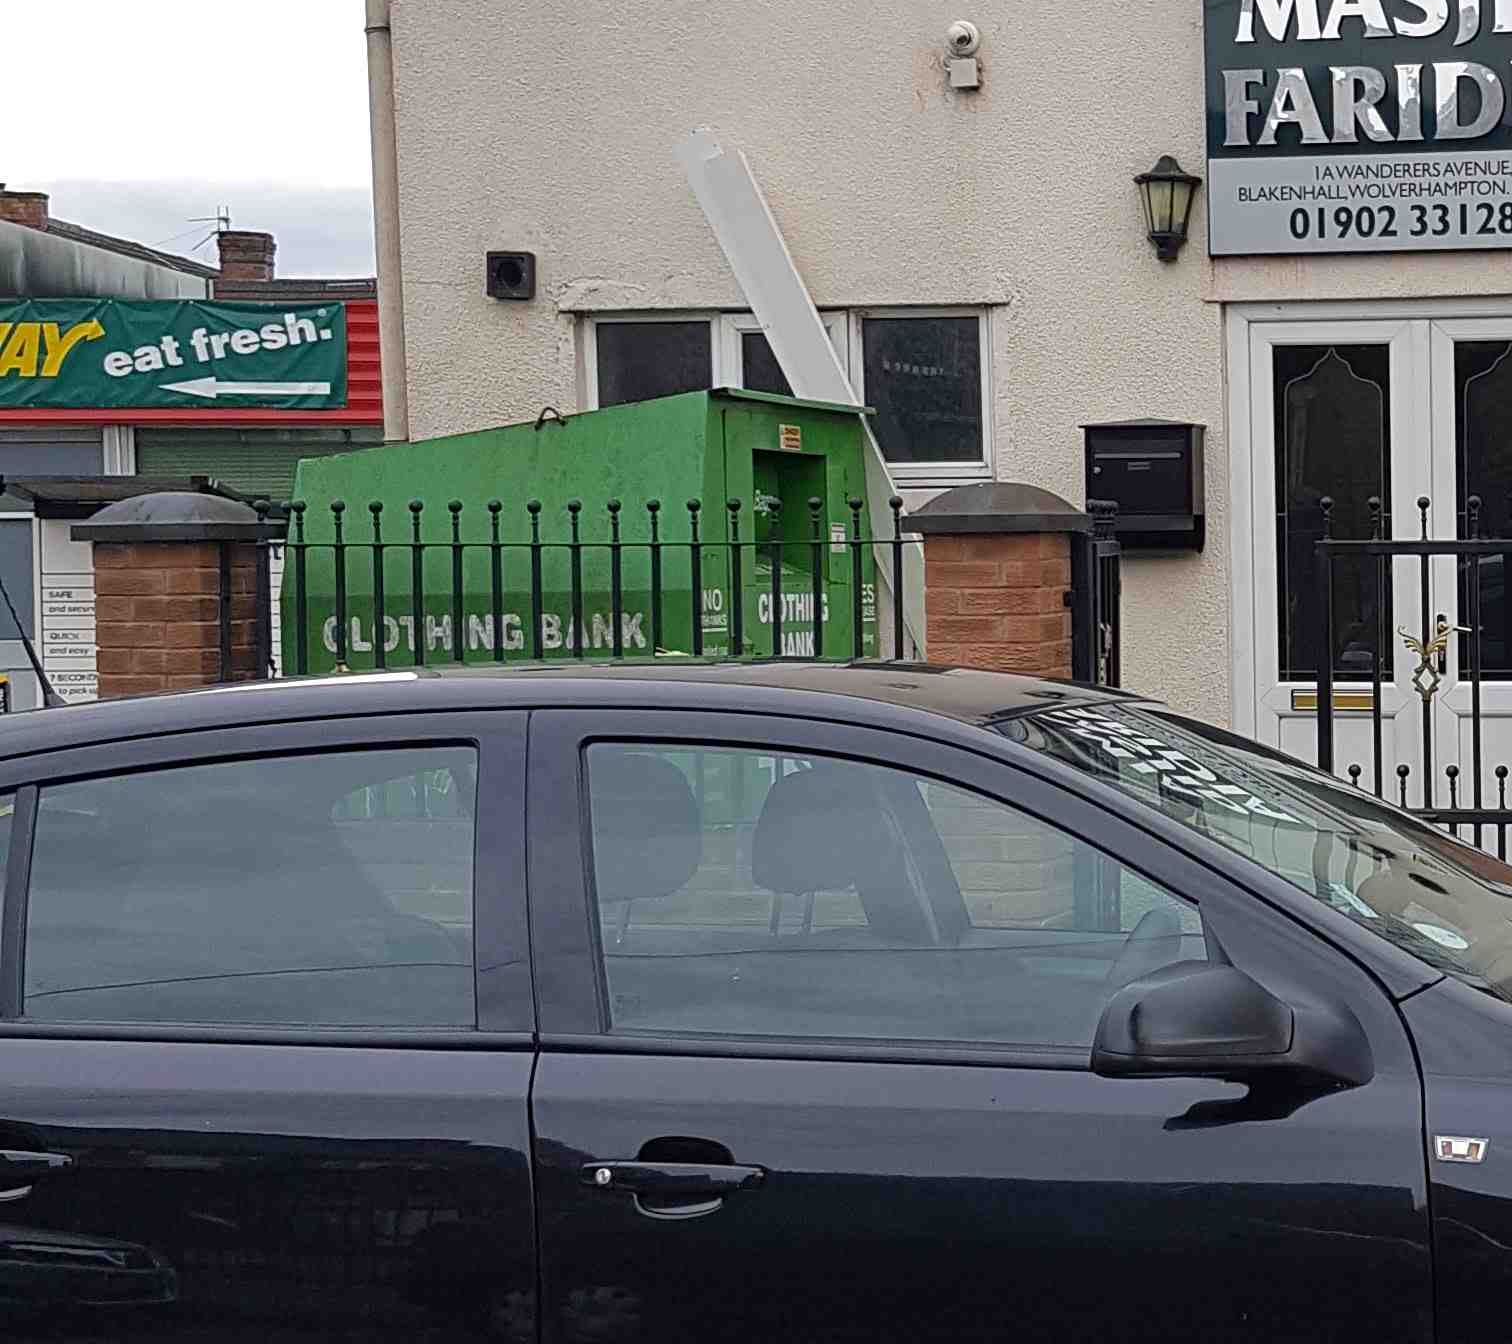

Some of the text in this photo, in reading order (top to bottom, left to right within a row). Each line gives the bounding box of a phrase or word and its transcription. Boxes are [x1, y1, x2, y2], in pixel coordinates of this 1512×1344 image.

[1336, 163, 1440, 179] WANDERERS
[1289, 205, 1398, 240] 01902
[0, 318, 105, 377] AY
[103, 335, 184, 377] eat
[703, 589, 723, 612] NO
[323, 612, 647, 654] CLOTHNG BANK
